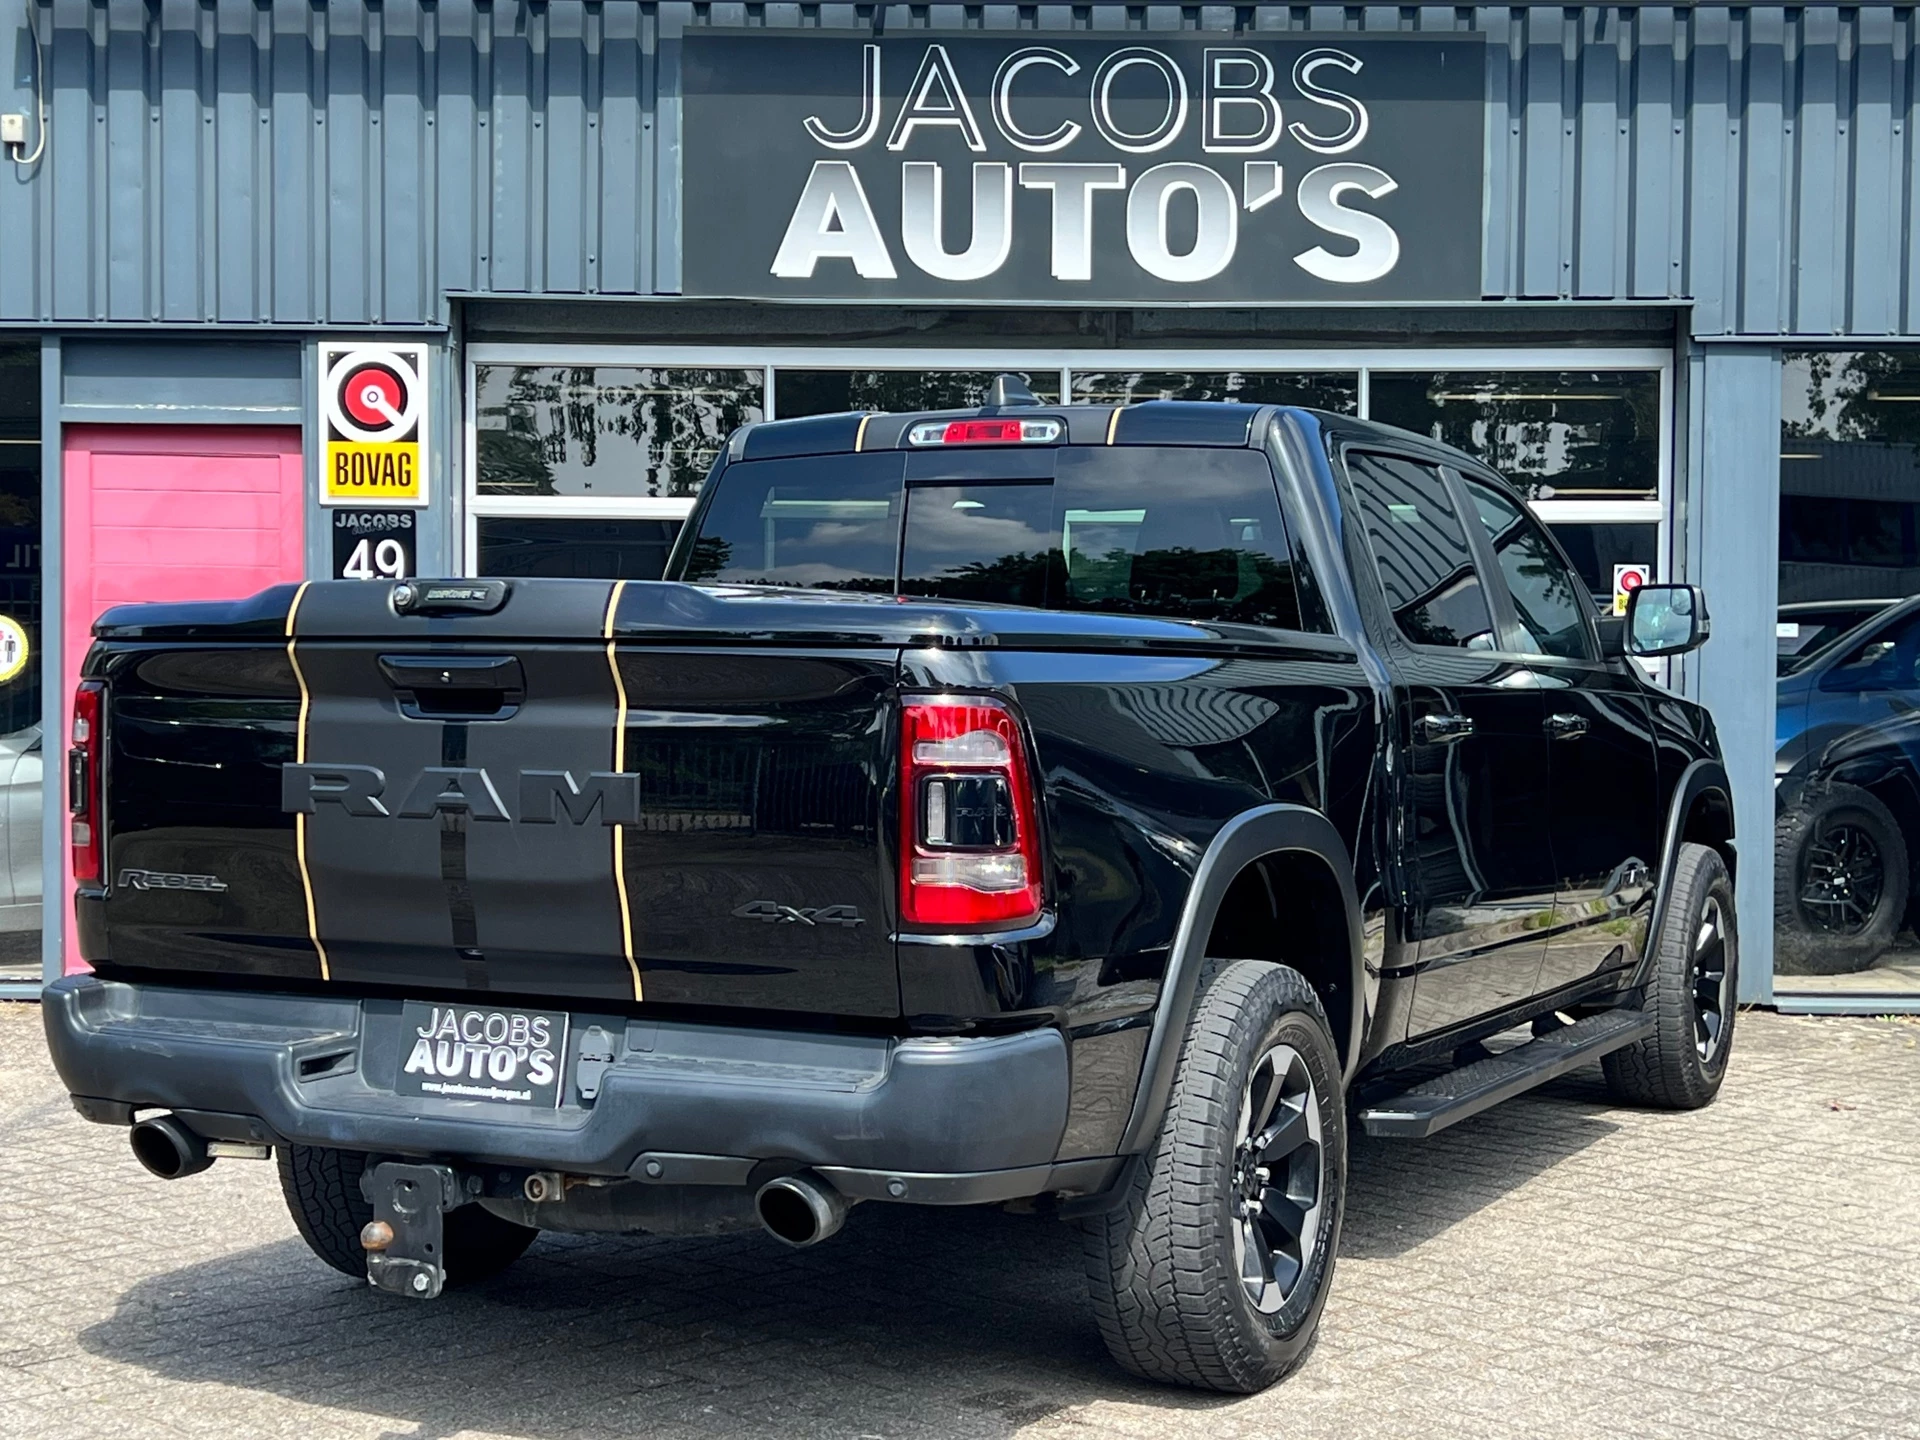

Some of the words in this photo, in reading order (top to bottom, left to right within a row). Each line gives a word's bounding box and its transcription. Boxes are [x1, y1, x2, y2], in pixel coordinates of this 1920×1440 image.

[803, 44, 1369, 154] JACOBS
[769, 160, 1400, 283] AUTO'S
[335, 451, 411, 487] BOVAG
[335, 513, 412, 528] JACOBS
[342, 538, 405, 580] 49
[281, 761, 641, 827] RAM
[416, 1007, 551, 1048] JACOBS
[403, 1038, 555, 1086] AUTO'S
